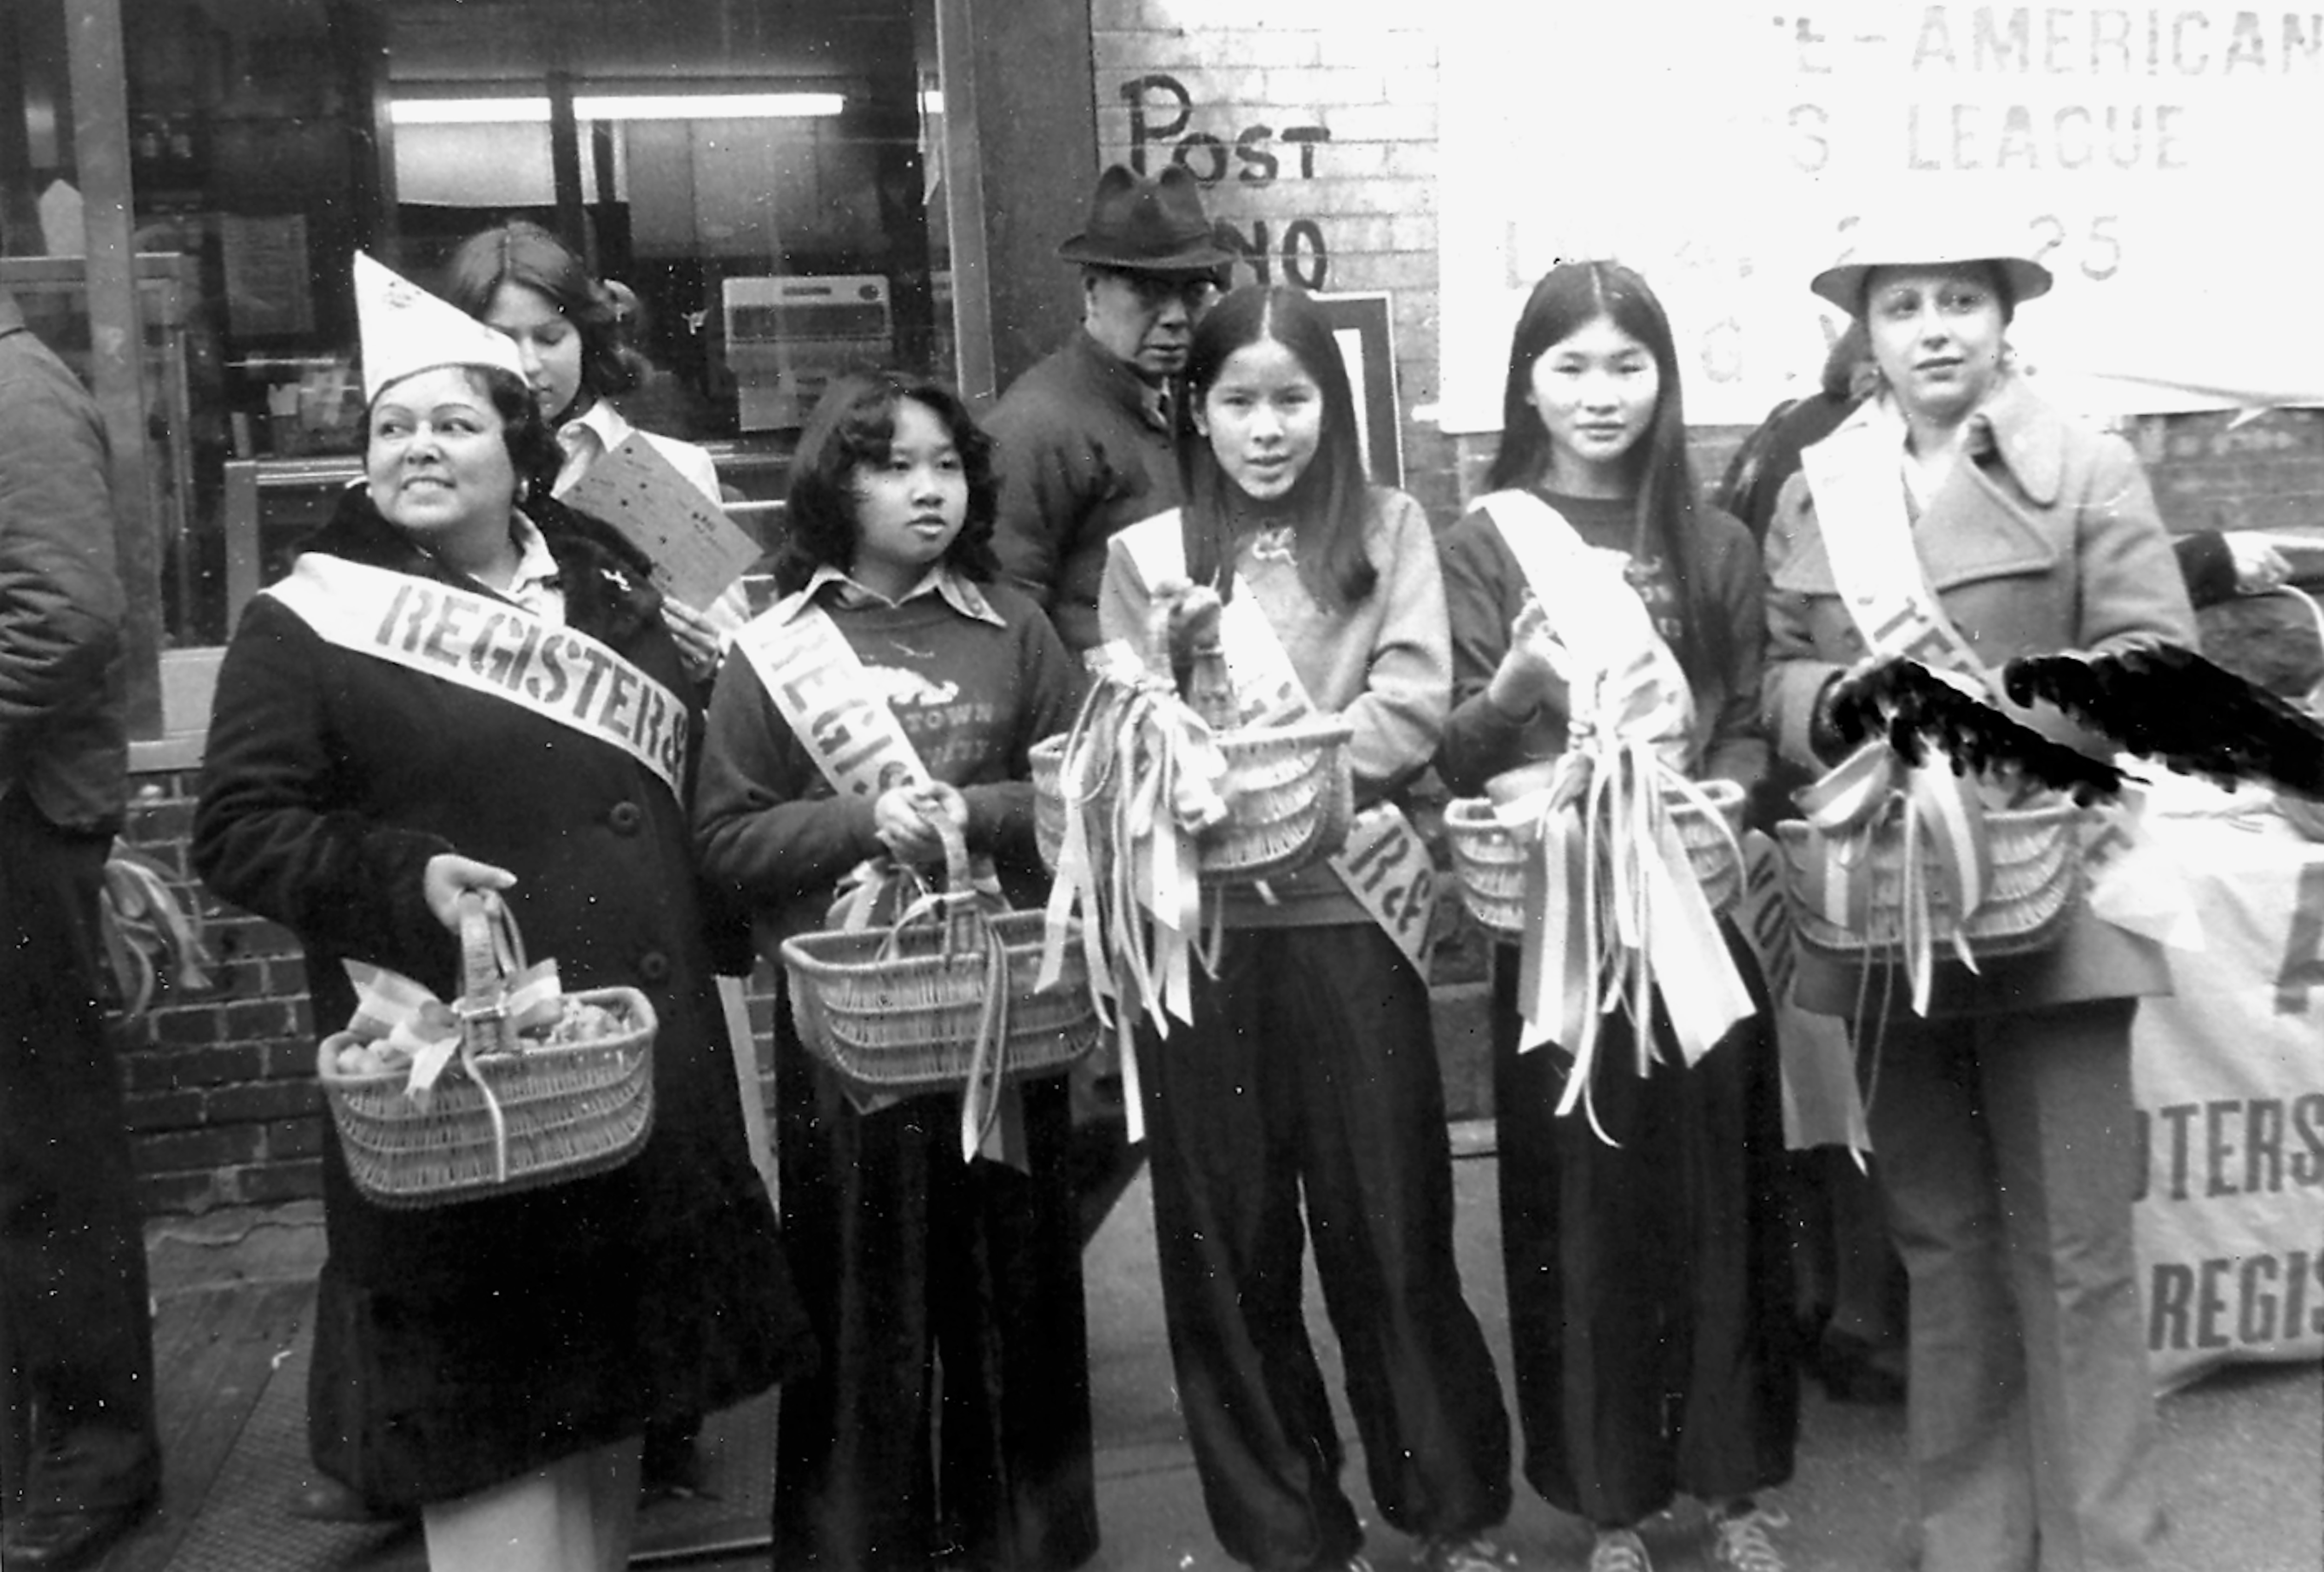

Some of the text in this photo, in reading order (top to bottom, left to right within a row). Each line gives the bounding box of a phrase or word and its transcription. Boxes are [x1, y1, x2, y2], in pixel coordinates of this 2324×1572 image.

[1121, 73, 1332, 187] POST
[1908, 104, 2189, 171] LEAGUE
[2148, 1250, 2324, 1352] REGI
